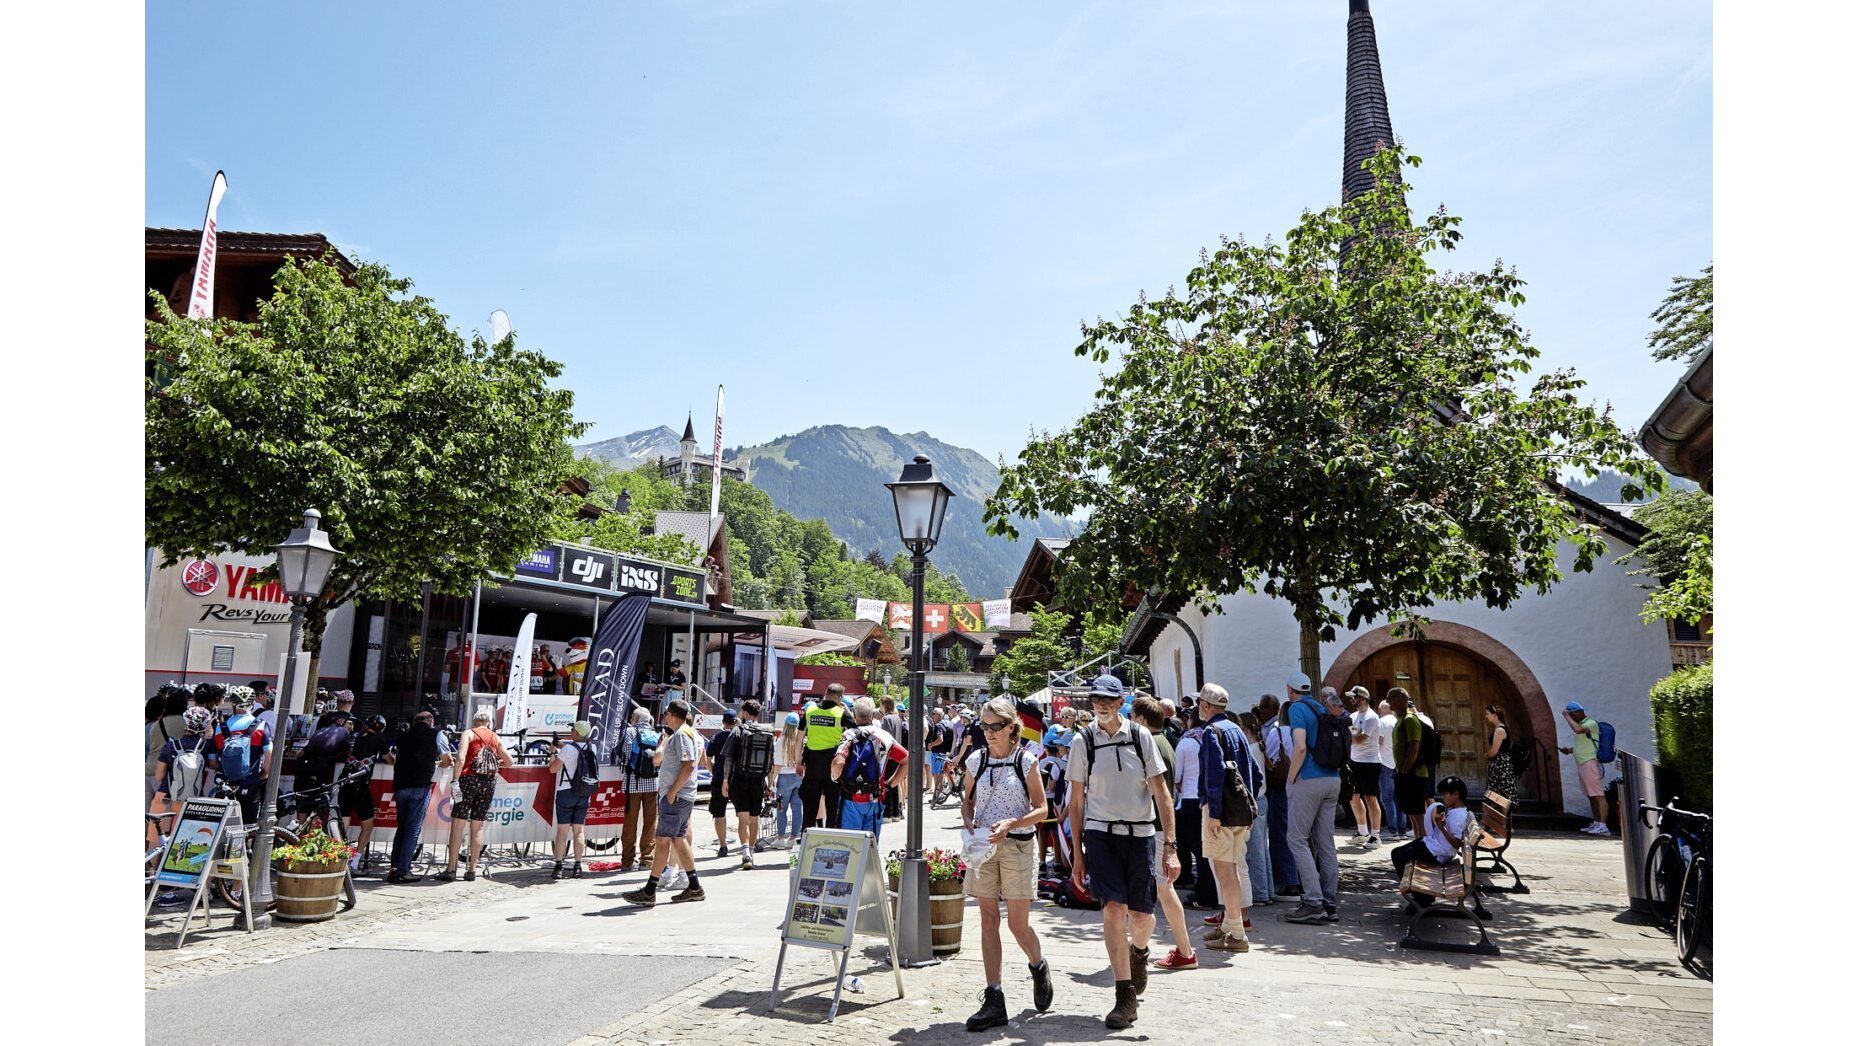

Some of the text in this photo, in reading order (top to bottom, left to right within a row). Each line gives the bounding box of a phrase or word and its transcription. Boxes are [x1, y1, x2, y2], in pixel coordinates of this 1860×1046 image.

[196, 218, 217, 301] YAMAHA
[225, 564, 289, 604] YAM
[200, 603, 254, 621] Revs
[619, 664, 629, 690] DOWN
[588, 648, 615, 741] STAAD
[616, 690, 625, 712] SLOW
[187, 804, 225, 813] PARAGLIDING
[492, 797, 523, 808] meo
